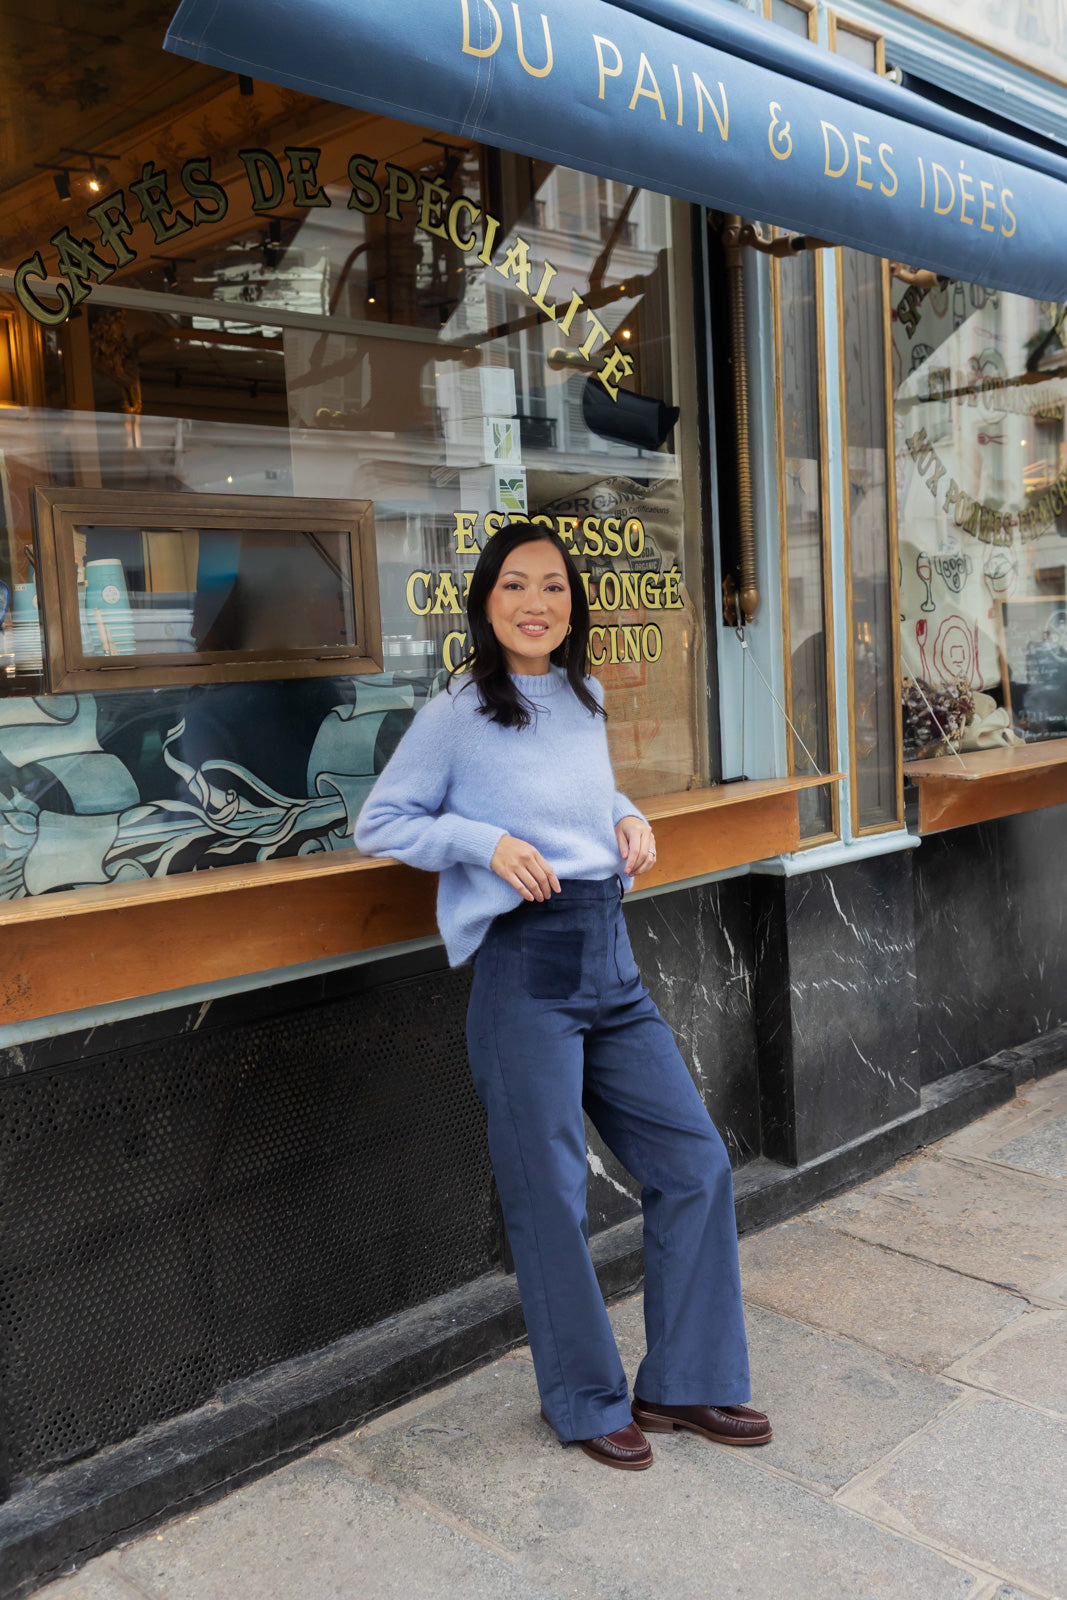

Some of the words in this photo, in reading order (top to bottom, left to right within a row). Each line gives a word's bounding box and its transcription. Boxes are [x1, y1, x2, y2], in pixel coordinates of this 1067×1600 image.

[461, 0, 554, 78] DU
[592, 34, 729, 142] PAIN
[767, 101, 793, 160] &
[820, 119, 899, 197] DES
[917, 157, 1017, 238] IDÉES
[14, 160, 229, 327] CAFÉS
[238, 146, 332, 211] DE
[905, 426, 947, 498] AUX
[453, 510, 646, 557] ESESSO
[580, 564, 685, 612] LONGÉ
